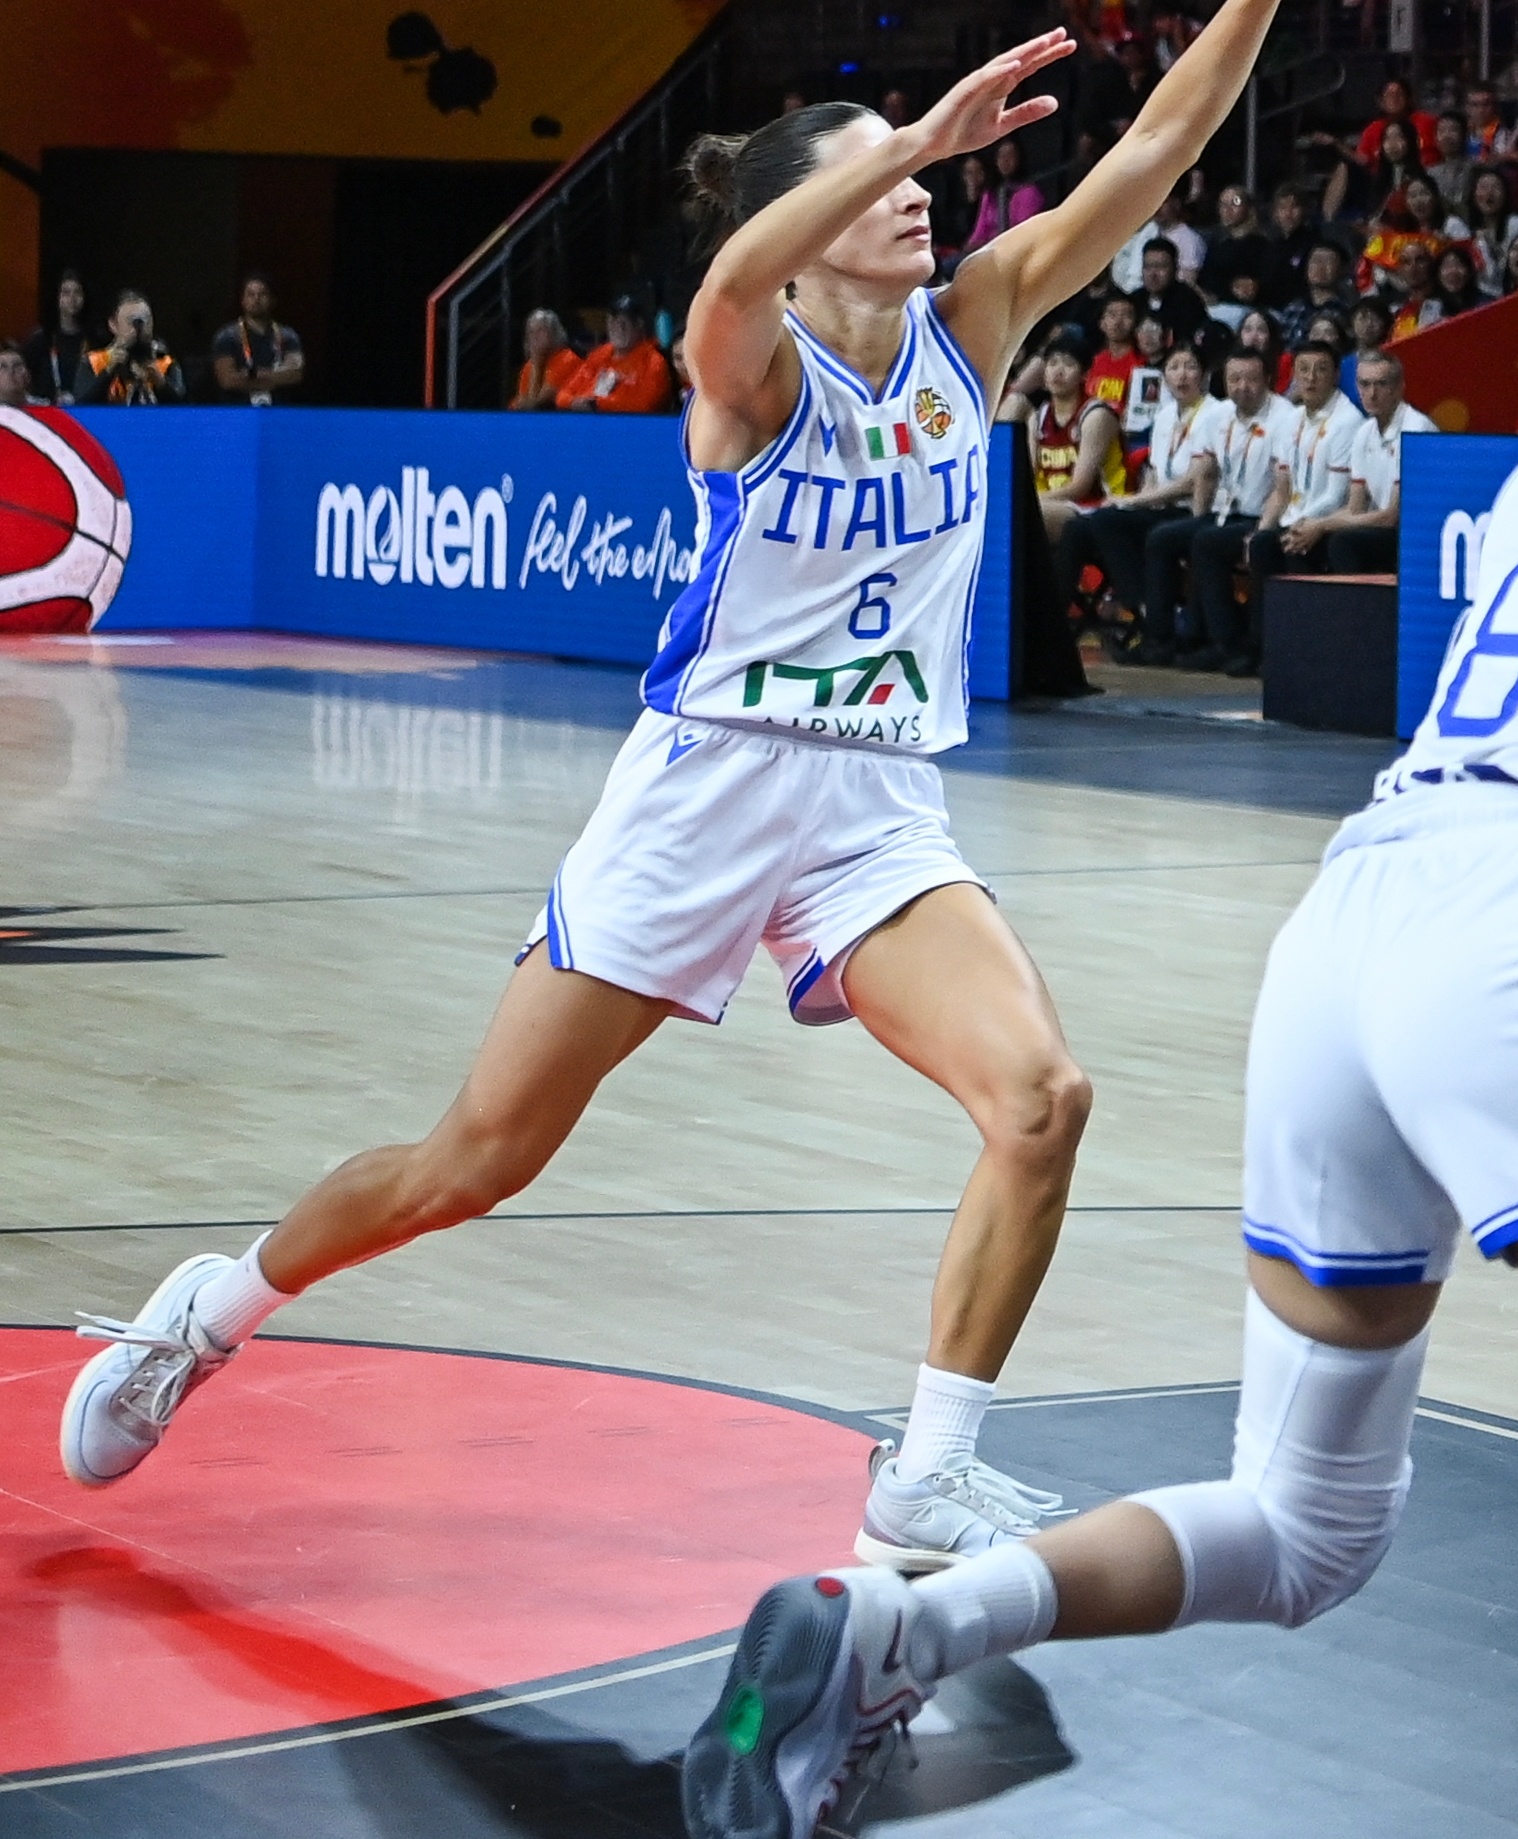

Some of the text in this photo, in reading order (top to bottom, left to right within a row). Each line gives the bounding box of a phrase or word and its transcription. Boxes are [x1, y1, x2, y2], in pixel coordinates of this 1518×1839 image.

[315, 466, 508, 590] molten
[518, 491, 588, 591] feel
[582, 512, 634, 585] the
[762, 444, 979, 551] ITALIA
[847, 572, 897, 639] 6
[742, 650, 929, 707] ITA
[762, 716, 922, 743] RWAYS
